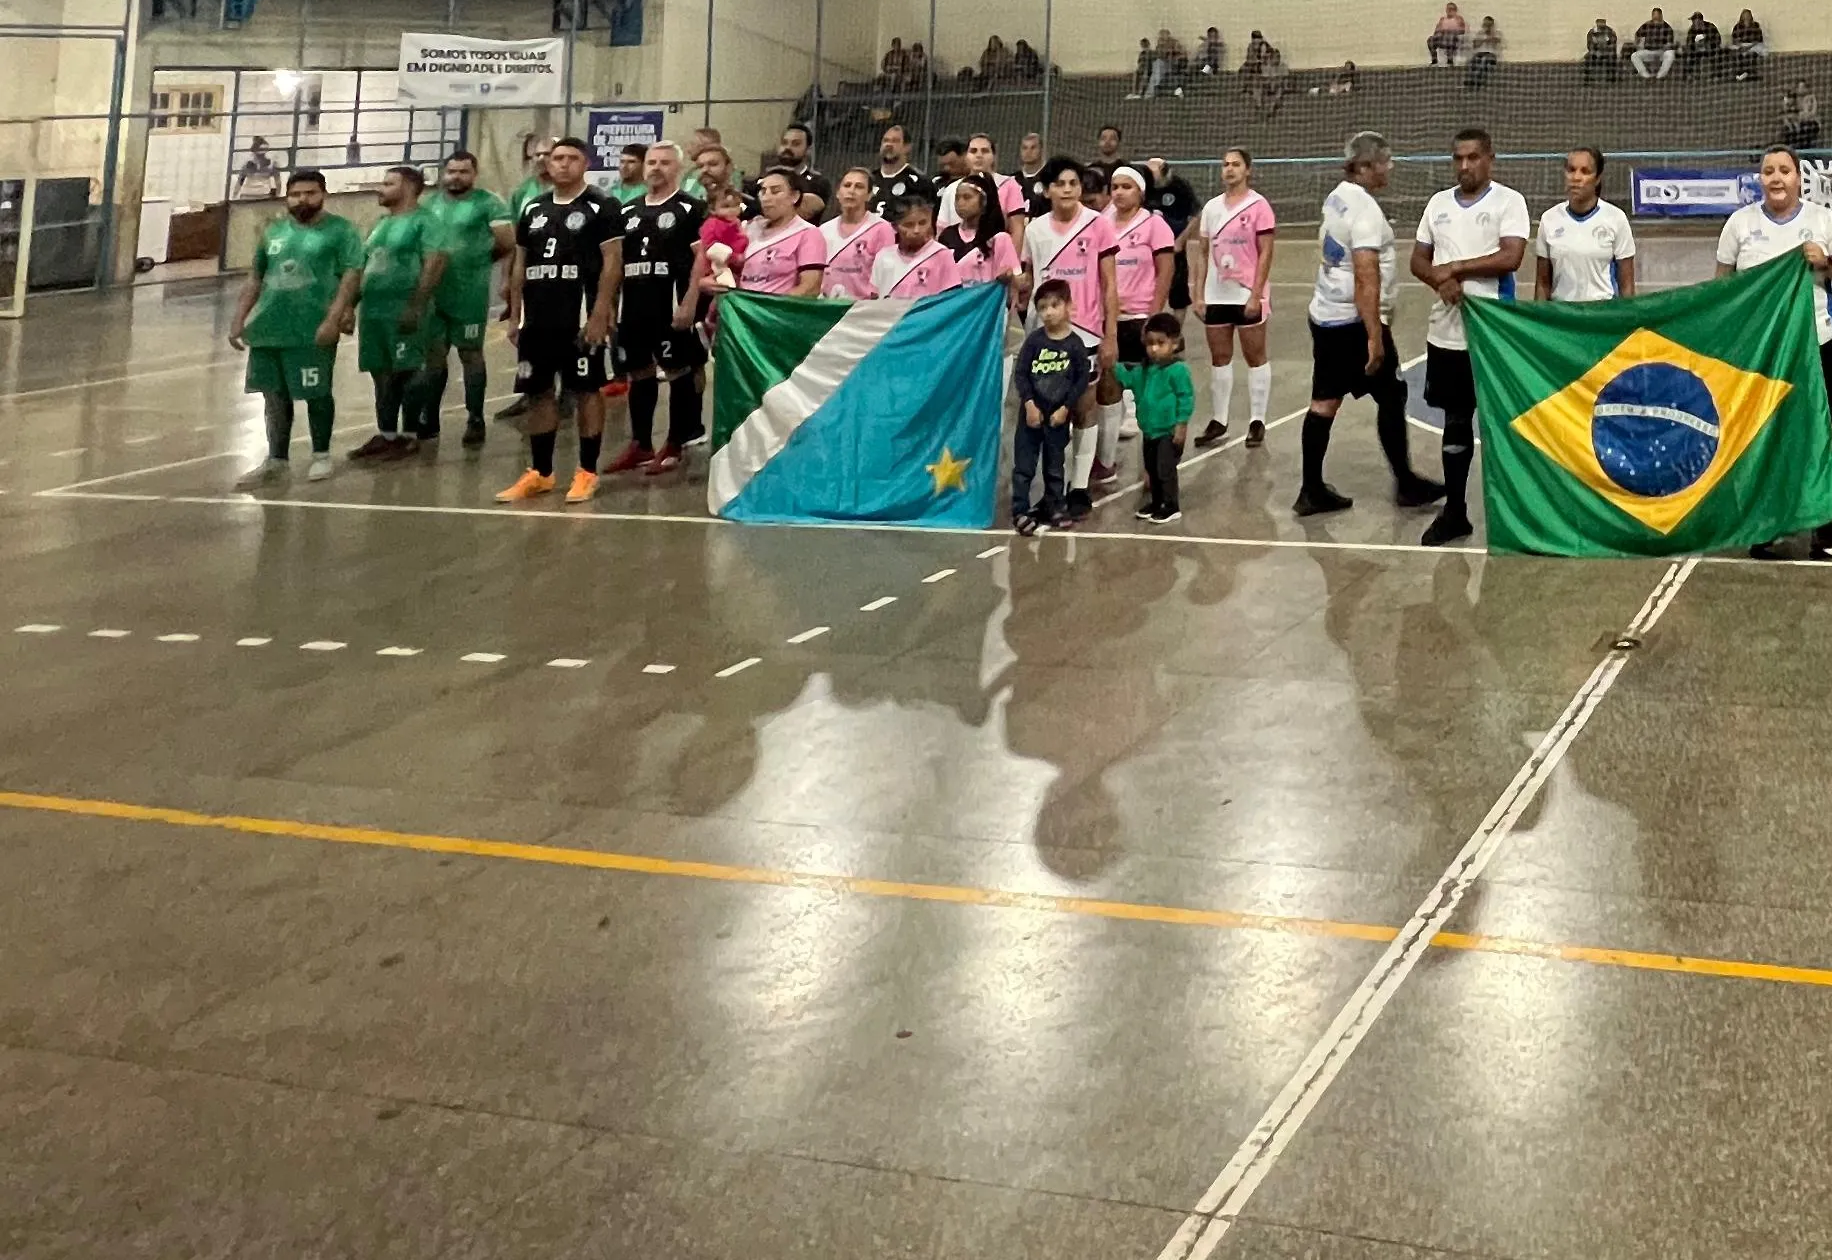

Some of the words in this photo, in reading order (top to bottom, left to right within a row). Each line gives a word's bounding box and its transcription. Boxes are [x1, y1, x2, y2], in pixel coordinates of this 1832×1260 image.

[420, 48, 467, 60] SOMOS
[469, 50, 508, 61] TODOS
[508, 51, 547, 61] IGUAIS
[406, 62, 427, 73] EM
[429, 63, 496, 74] DIGNIDADE
[543, 237, 557, 258] 9
[661, 340, 673, 358] 2
[577, 357, 589, 377] 9
[301, 367, 320, 387] 15
